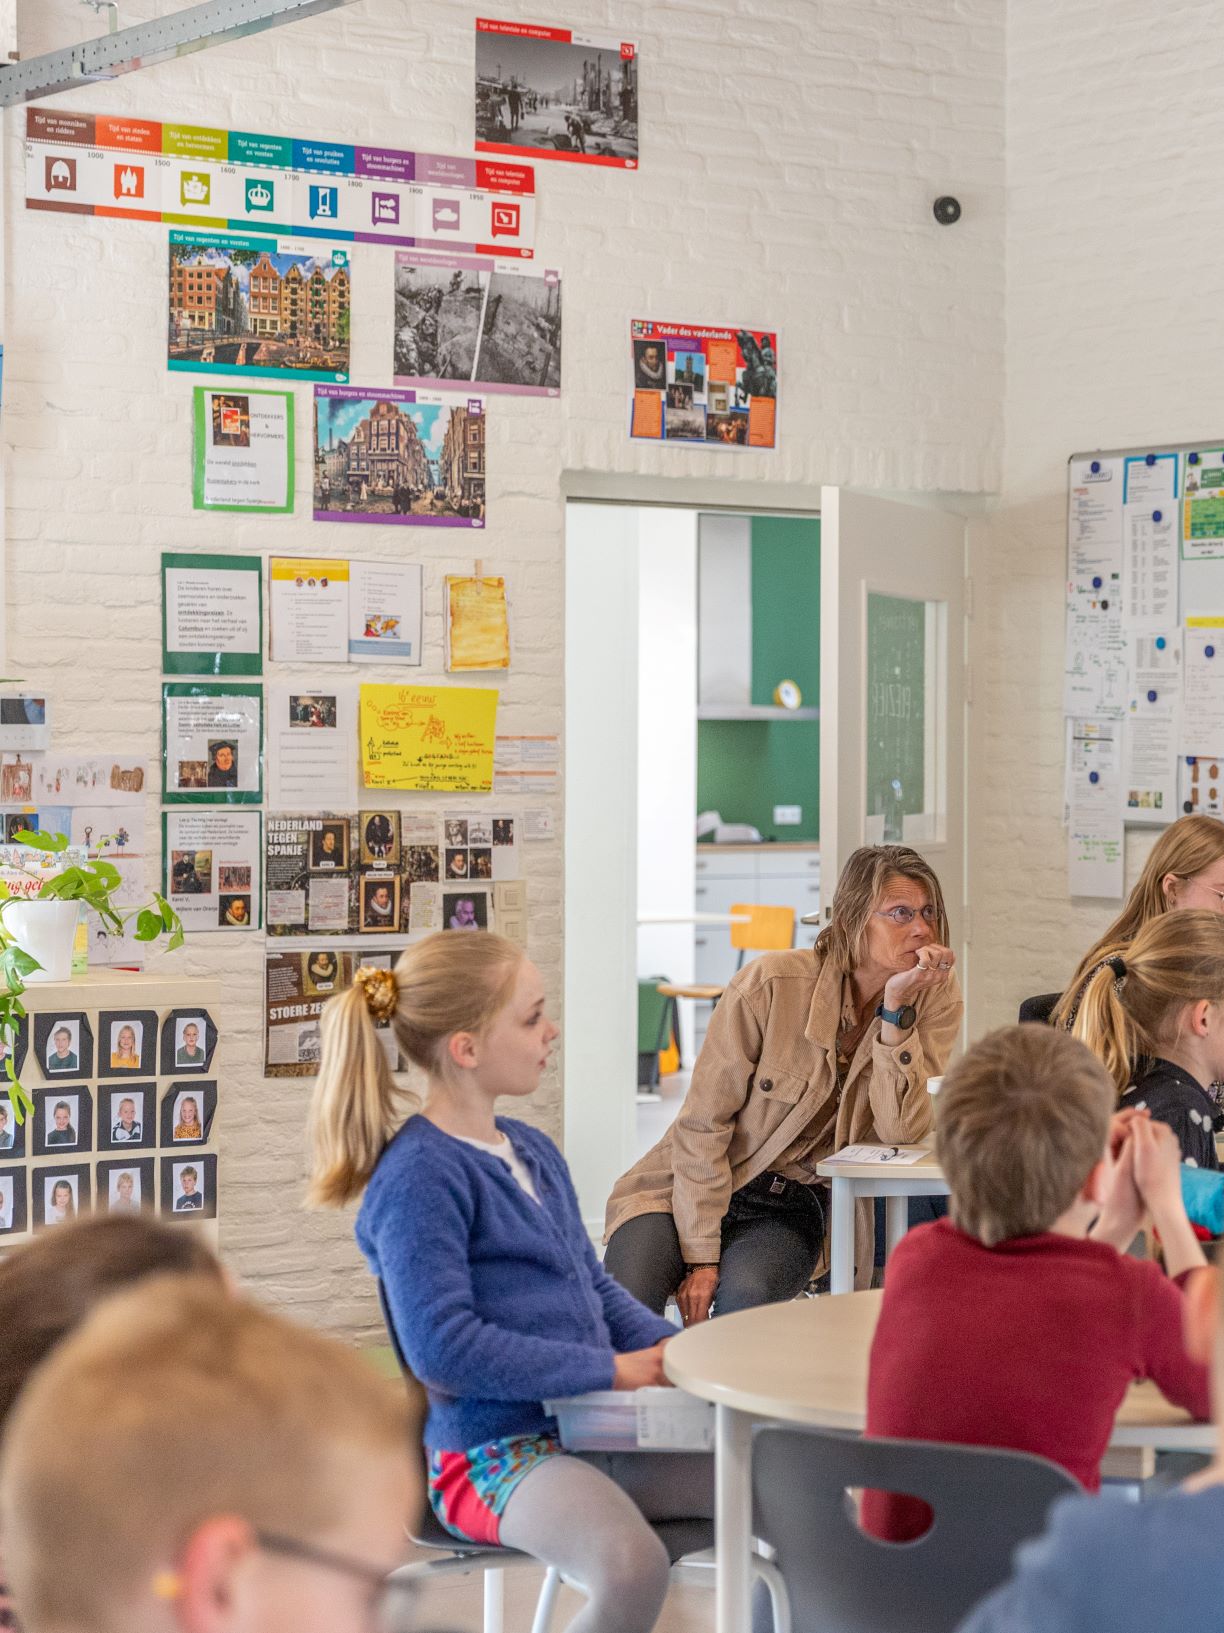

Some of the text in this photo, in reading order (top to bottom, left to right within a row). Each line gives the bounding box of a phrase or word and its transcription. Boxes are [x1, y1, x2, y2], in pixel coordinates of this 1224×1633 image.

[35, 116, 46, 124] Tijd
[46, 126, 54, 134] en
[109, 124, 119, 132] Tijd
[238, 139, 248, 148] Tijd
[302, 147, 312, 155] Tijd
[87, 151, 104, 160] 1000
[362, 153, 372, 162] Tijd
[155, 159, 171, 168] 1500
[220, 167, 236, 175] 1600
[485, 168, 495, 176] Tijd
[348, 180, 363, 188] 1800
[409, 187, 423, 195] 1900
[470, 193, 484, 201] 1950
[174, 233, 184, 241] Tijd
[657, 324, 732, 340] Vader des vaderlands
[318, 388, 328, 396] Tijd
[267, 820, 323, 831] NEDERLAND
[267, 833, 298, 844] TEGEN
[267, 845, 303, 856] SPANJE
[269, 1003, 309, 1020] STOERE
